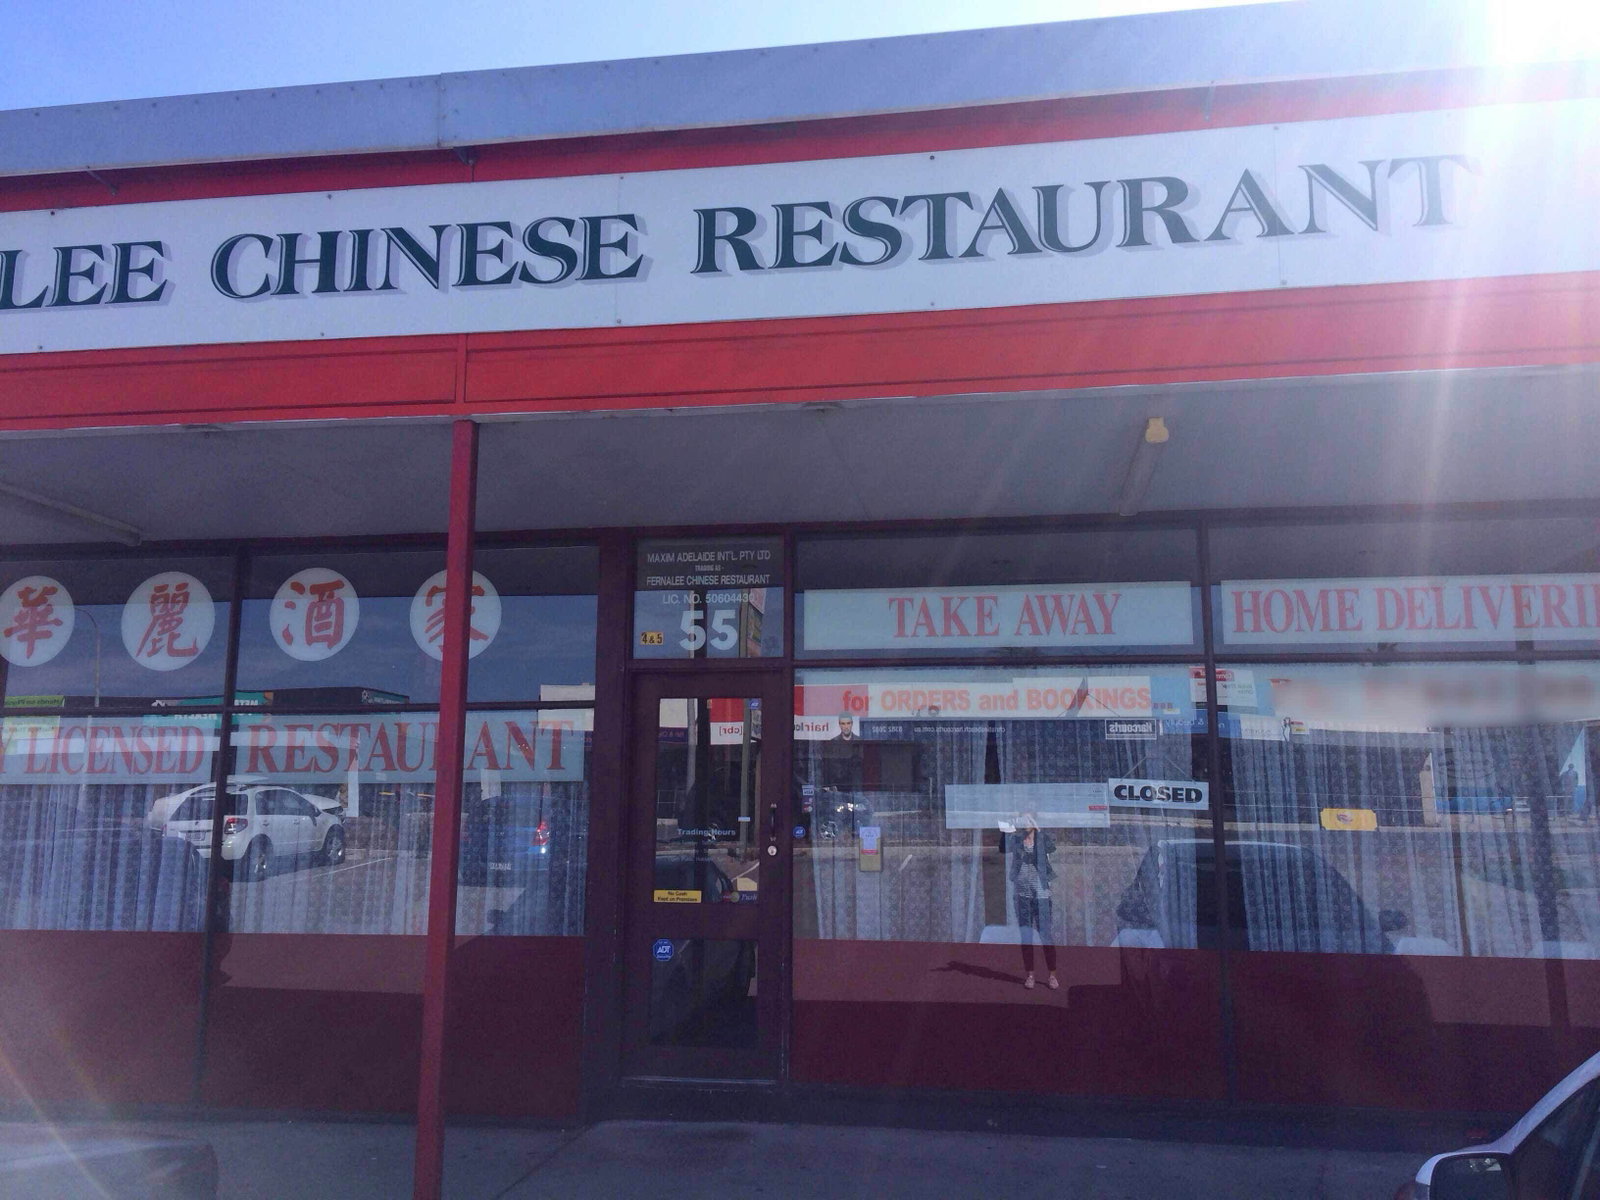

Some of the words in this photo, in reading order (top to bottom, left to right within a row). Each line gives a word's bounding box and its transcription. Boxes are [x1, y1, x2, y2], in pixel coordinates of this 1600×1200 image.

[0, 240, 168, 310] LEE
[210, 213, 645, 299] CHINESE
[690, 154, 1476, 275] RESTAURANT
[647, 552, 675, 563] MAXIM
[677, 551, 716, 562] ADELAIDE
[739, 550, 756, 561] PTY
[757, 549, 771, 560] LTD
[646, 575, 685, 587] FERNALEE
[686, 575, 719, 585] CHINESE
[720, 574, 770, 585] RESTAURANT
[684, 593, 702, 604] NO.
[888, 595, 1000, 638] TAKE
[1013, 593, 1122, 636] AWAY
[1231, 587, 1363, 633] HOME
[679, 609, 738, 651] 55
[843, 689, 872, 712] for
[880, 689, 971, 712] ORDERS
[978, 688, 1019, 711] and
[22, 720, 203, 775] LICENSED
[1113, 784, 1203, 803] CLOSED
[677, 828, 711, 837] Trading
[712, 828, 736, 836] Hours
[656, 945, 671, 954] ADT
